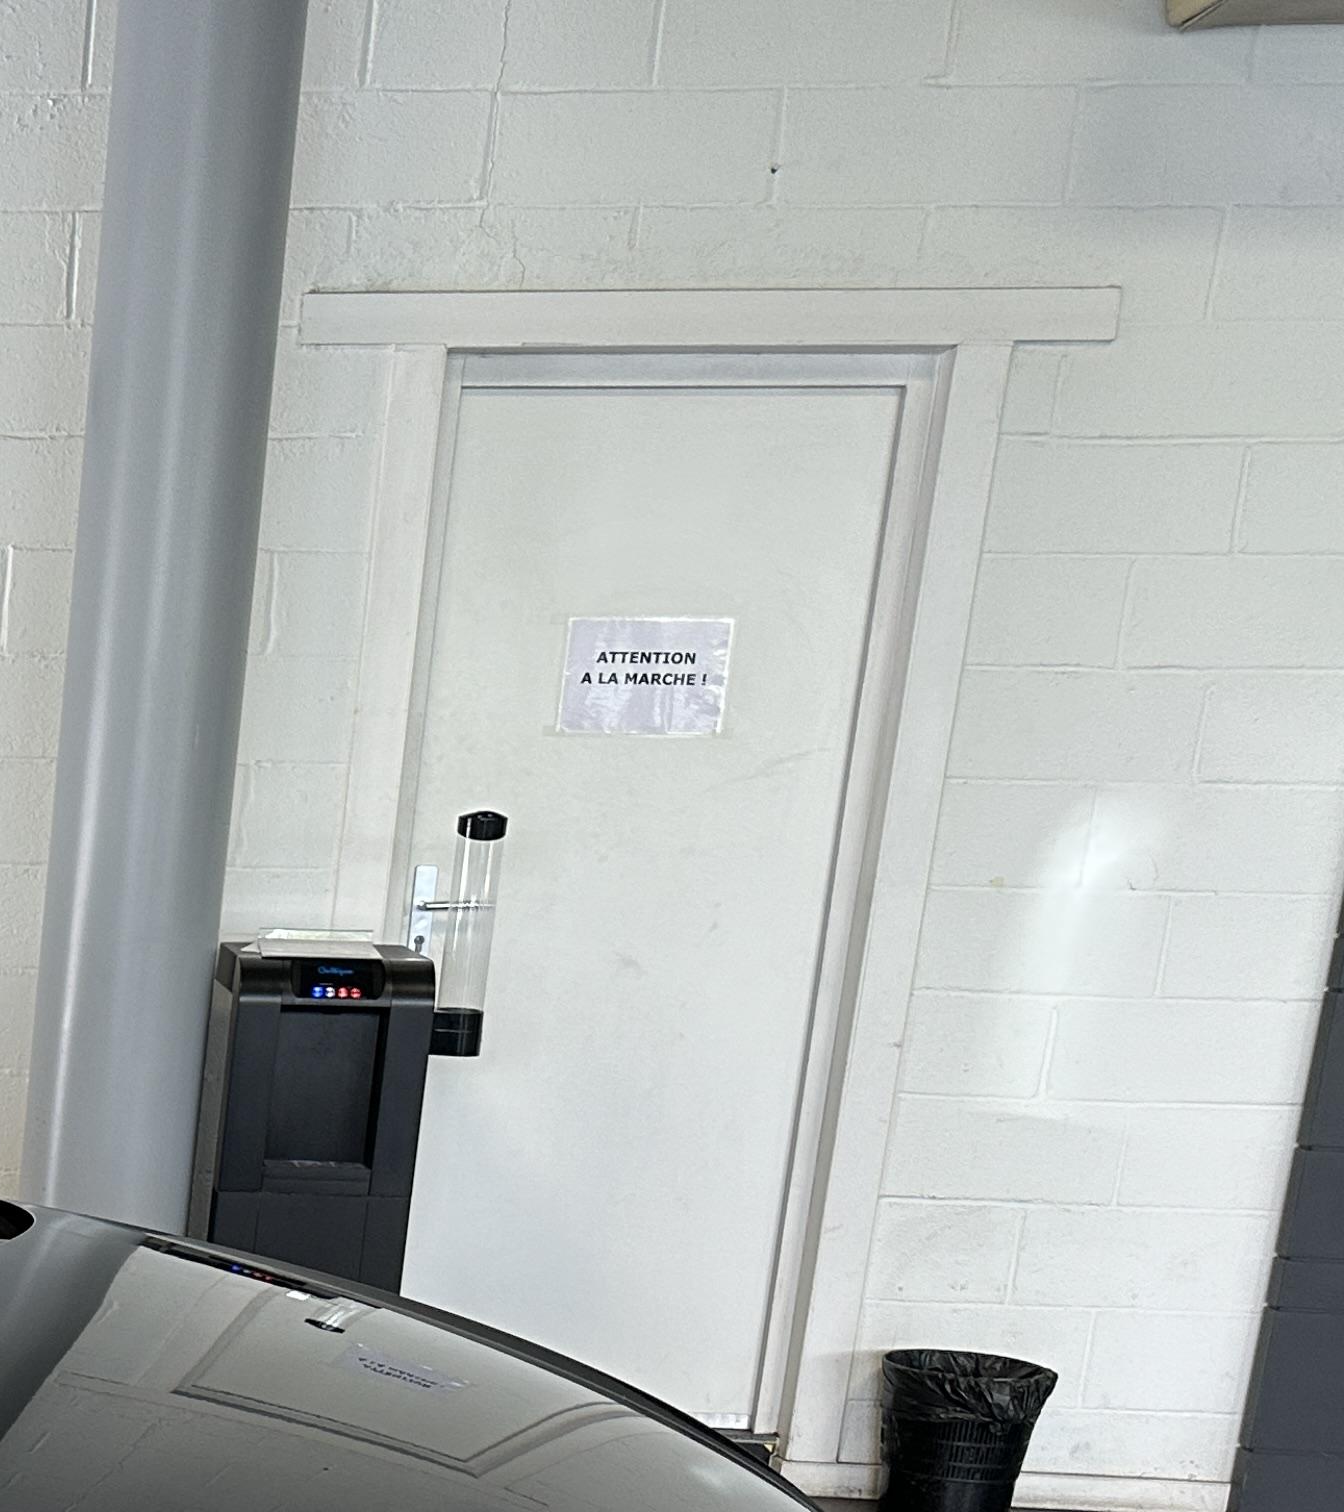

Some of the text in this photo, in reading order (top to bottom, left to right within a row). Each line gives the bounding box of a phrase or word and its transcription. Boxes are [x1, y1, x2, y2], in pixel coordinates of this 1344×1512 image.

[596, 652, 697, 665] ATTENTION
[581, 672, 593, 684] A
[598, 673, 618, 685] LA
[624, 673, 696, 686] MARCHE
